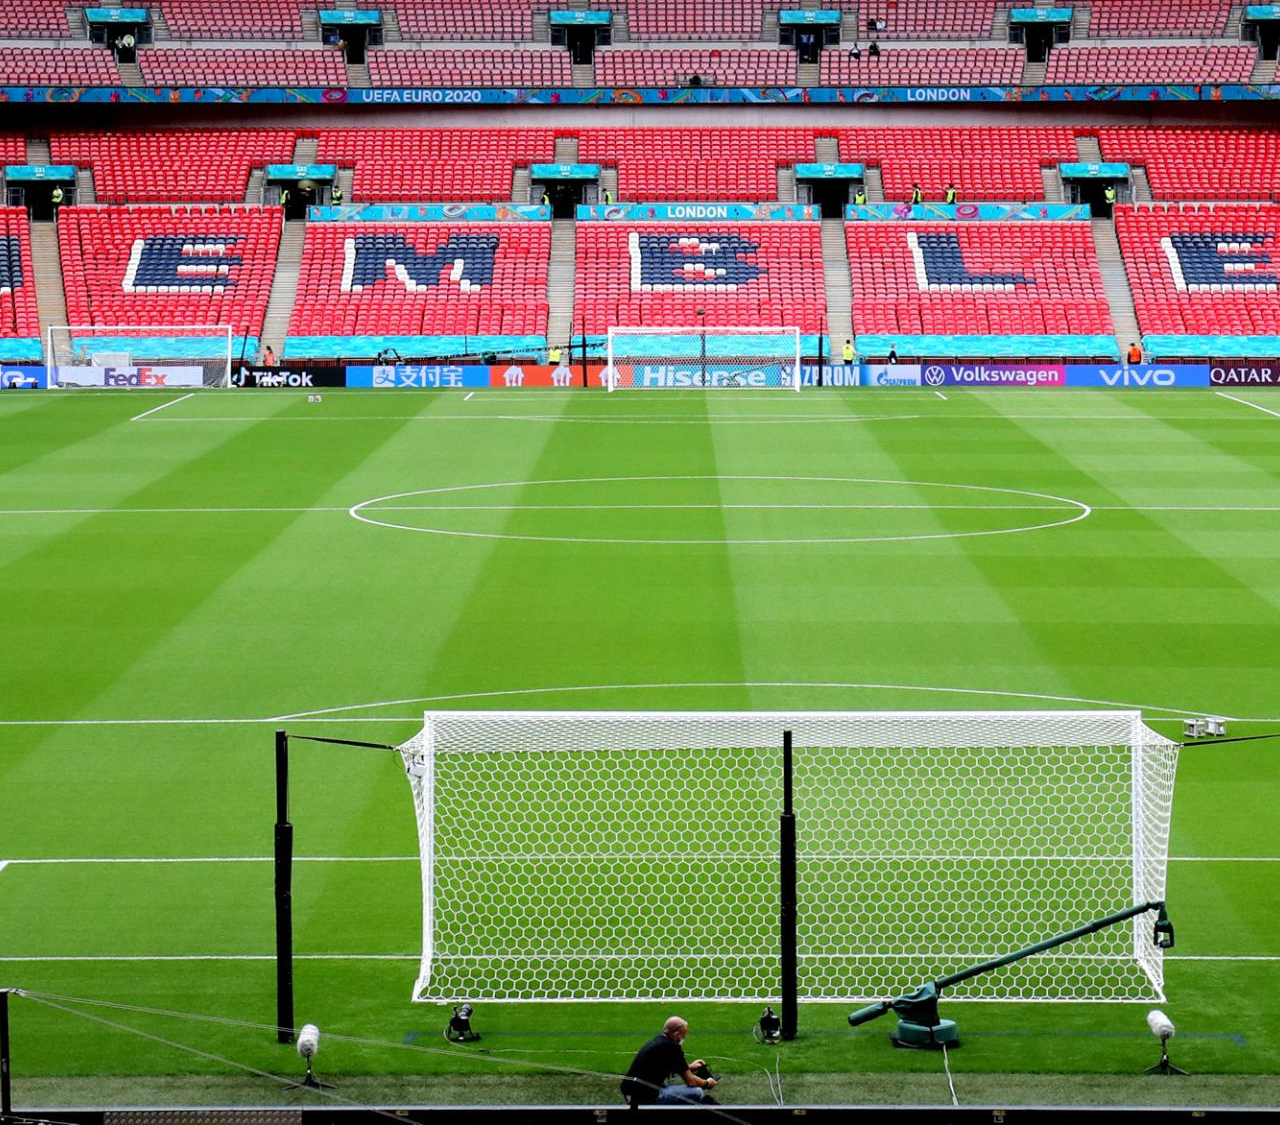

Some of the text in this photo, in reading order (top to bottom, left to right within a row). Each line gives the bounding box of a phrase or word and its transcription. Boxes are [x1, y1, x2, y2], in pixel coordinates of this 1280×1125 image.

[361, 89, 482, 102] UEFA EURO 2020
[907, 88, 971, 101] LONDON
[667, 206, 728, 218] LONDON
[104, 368, 168, 386] FedEx
[252, 371, 313, 387] TikTok
[398, 365, 463, 387] 支付宝
[643, 365, 767, 387] Hisense
[781, 366, 860, 386] GAZPROM
[951, 366, 1059, 386] Volkswagen
[1099, 365, 1175, 386] vivo
[1210, 367, 1272, 384] QATAR
